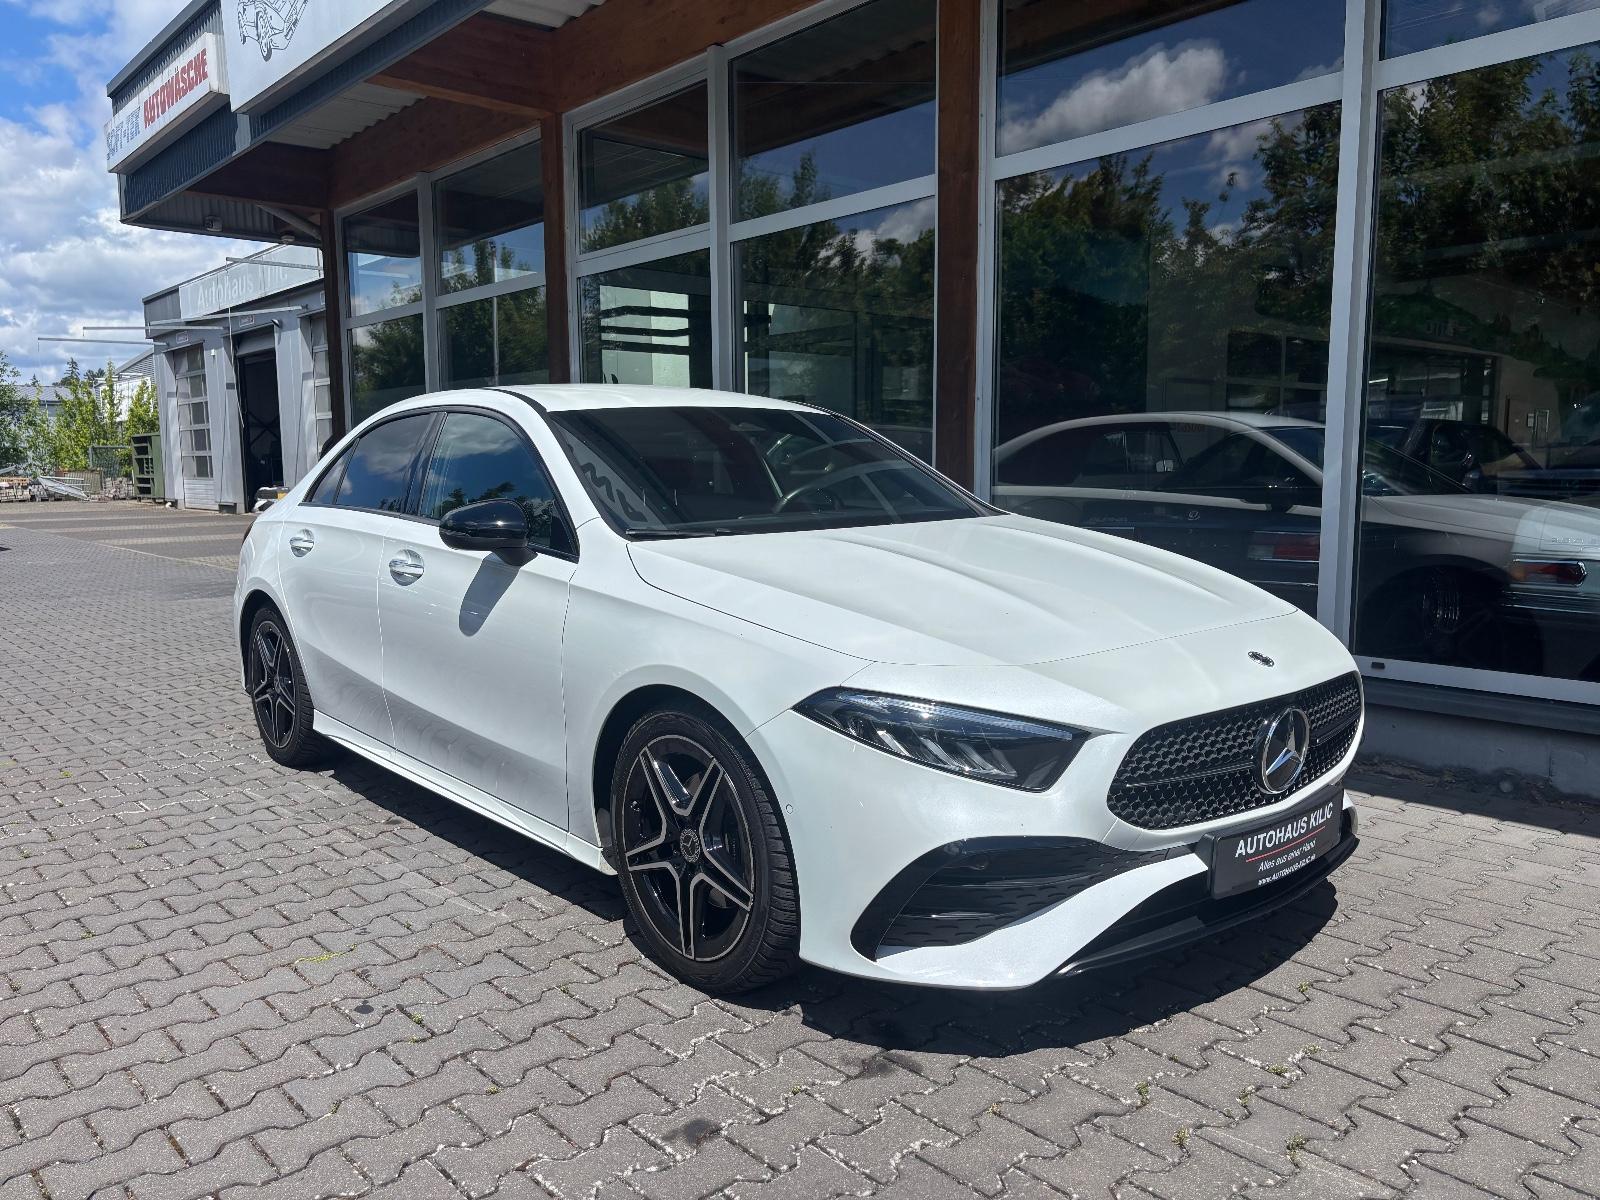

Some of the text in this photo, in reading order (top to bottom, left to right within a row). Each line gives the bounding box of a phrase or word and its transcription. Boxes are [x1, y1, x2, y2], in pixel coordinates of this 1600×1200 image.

[143, 48, 208, 129] AUTOWÄSCHE
[197, 273, 253, 308] Autohaus
[1235, 801, 1334, 858] AUTOHAUS KILIC
[1258, 838, 1317, 872] Alles aus einer Hand
